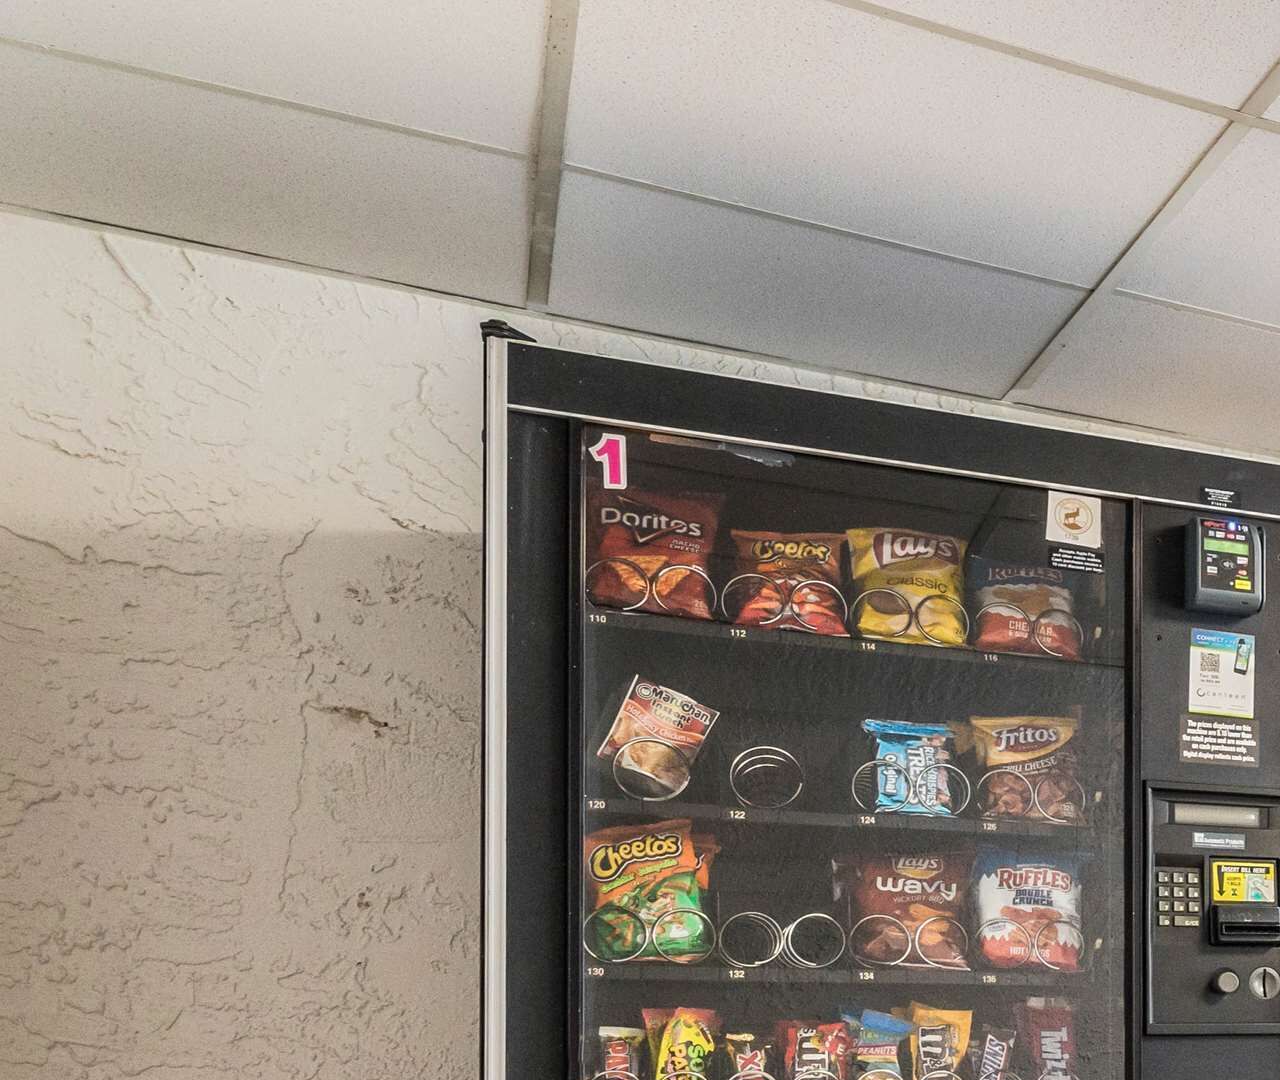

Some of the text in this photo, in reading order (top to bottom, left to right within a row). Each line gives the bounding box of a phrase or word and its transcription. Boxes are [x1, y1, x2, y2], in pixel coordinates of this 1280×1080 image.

[590, 433, 627, 489] 1
[601, 507, 701, 536] Doritos
[588, 614, 607, 624] 110
[1009, 620, 1053, 635] CHEAR
[729, 628, 747, 638] 112
[860, 643, 876, 651] 114
[983, 654, 998, 663] 116
[652, 686, 710, 725] Maruchan
[992, 727, 1057, 751] Fritos
[883, 754, 898, 793] Oiginal
[587, 800, 606, 809] 120
[728, 810, 746, 819] 122
[860, 816, 876, 825] 124
[591, 835, 681, 880] Cheetos
[997, 868, 1071, 892] RUFFLES
[876, 876, 957, 901] wavy
[586, 967, 605, 976] 130
[728, 970, 745, 979] 132
[858, 972, 875, 980] 134
[858, 1047, 897, 1056] PEANUTS
